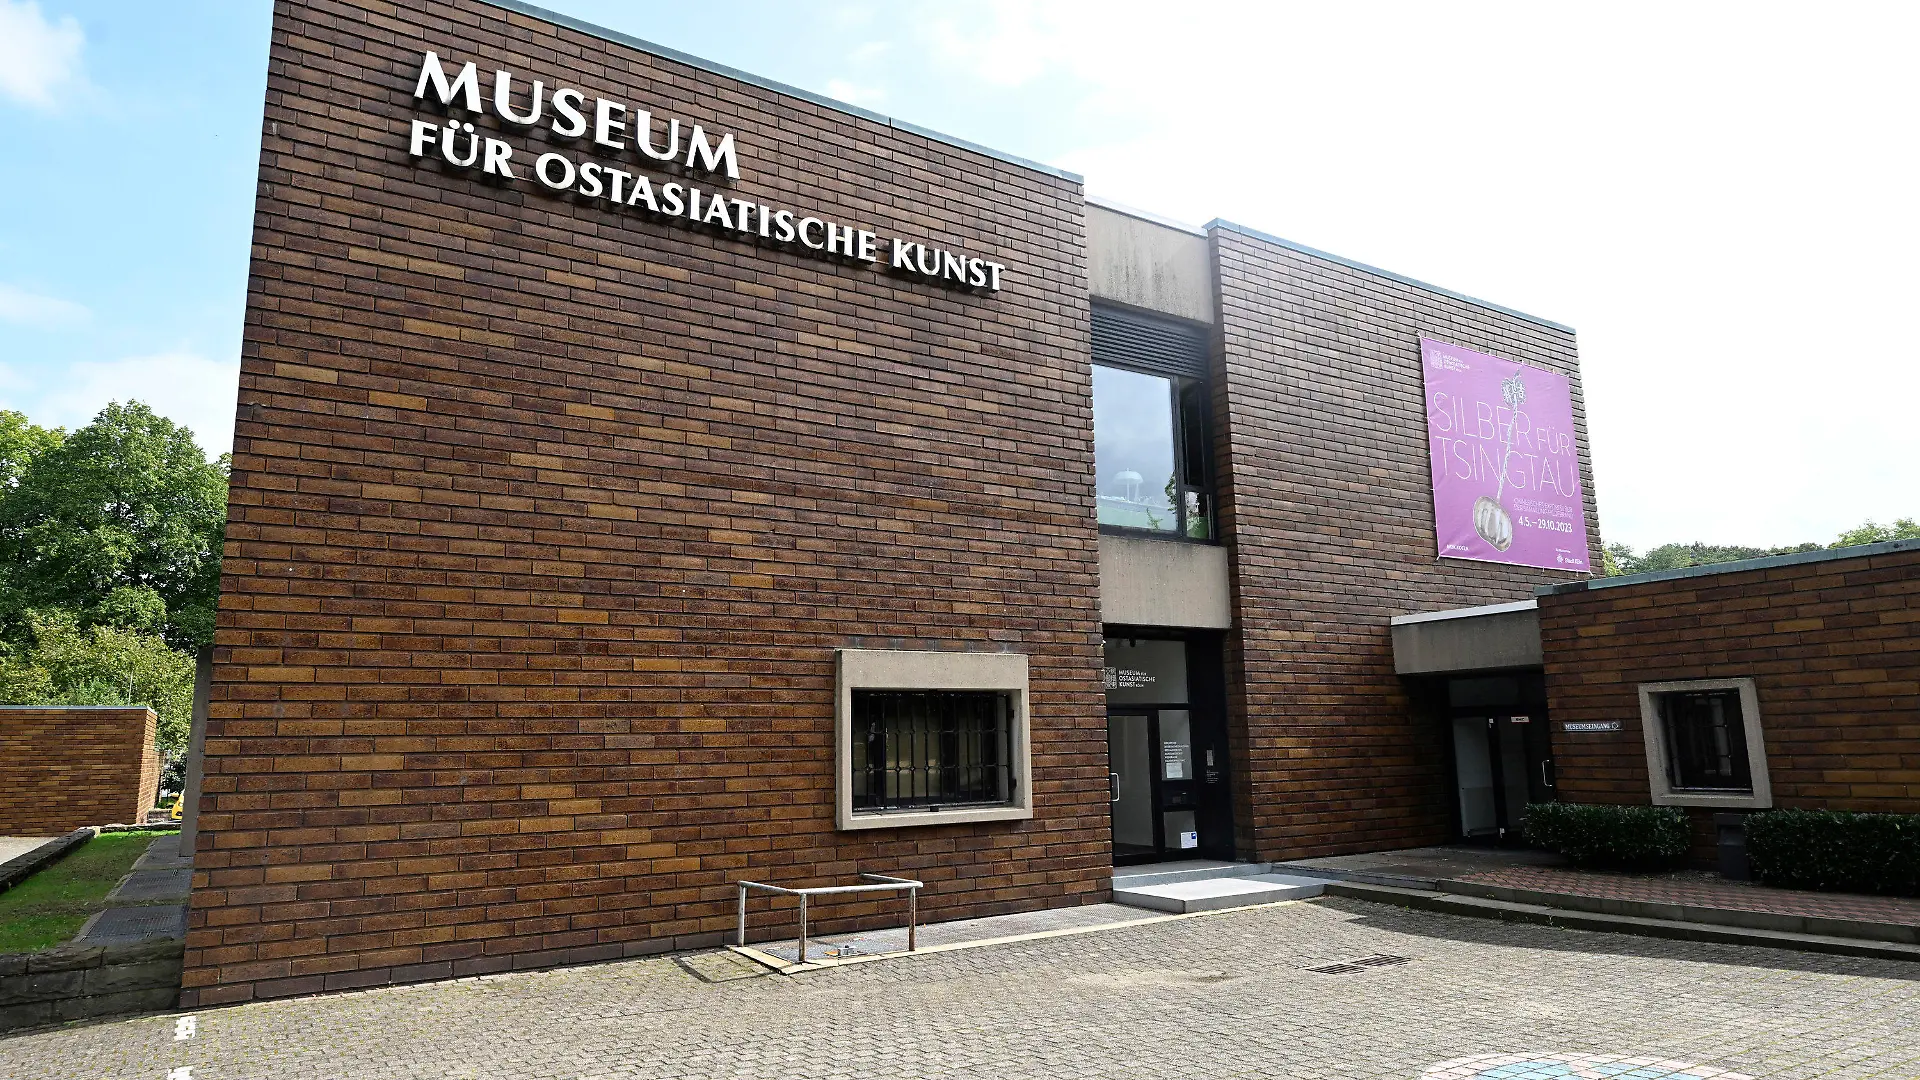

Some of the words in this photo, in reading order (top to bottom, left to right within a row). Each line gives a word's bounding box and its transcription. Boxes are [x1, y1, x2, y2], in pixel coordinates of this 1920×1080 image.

[413, 50, 740, 181] MUSEUM
[409, 118, 515, 180] FÜR
[534, 151, 877, 264] OSTASIATISCHE
[890, 239, 1005, 293] KUNST
[1433, 391, 1533, 449] SILBER
[1536, 425, 1571, 457] FÜR
[1434, 435, 1575, 498] TSINGTAU
